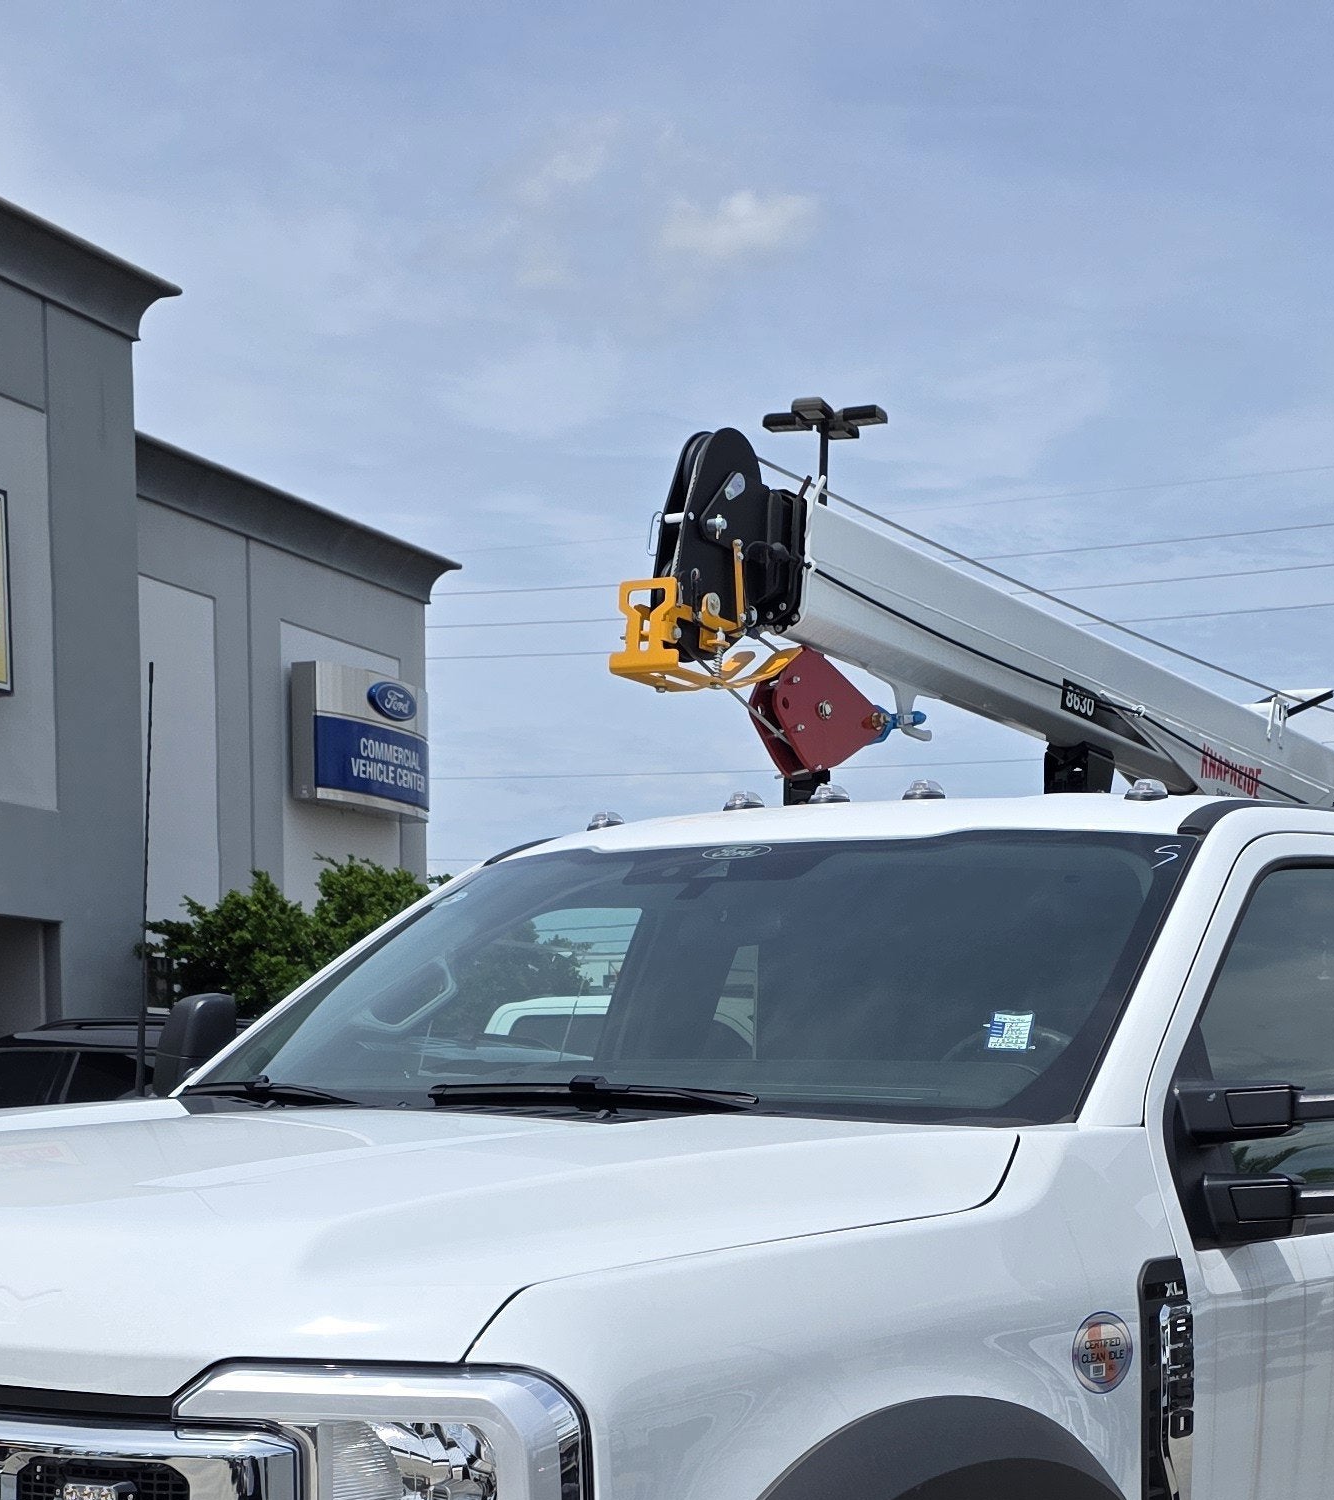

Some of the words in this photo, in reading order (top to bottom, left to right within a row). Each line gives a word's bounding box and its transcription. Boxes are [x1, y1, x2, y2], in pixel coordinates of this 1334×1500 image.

[383, 689, 411, 715] Ford
[1065, 686, 1095, 717] 8630
[360, 737, 422, 770] COMMERCIAL
[351, 757, 395, 784] VEHICLE
[396, 767, 426, 794] CENTER
[1200, 743, 1262, 799] KNAPHEIDE
[1165, 1281, 1184, 1298] XL
[1082, 1351, 1106, 1364] CLEAN
[1109, 1349, 1125, 1361] IDLE
[1085, 1337, 1121, 1350] CERTIFIED
